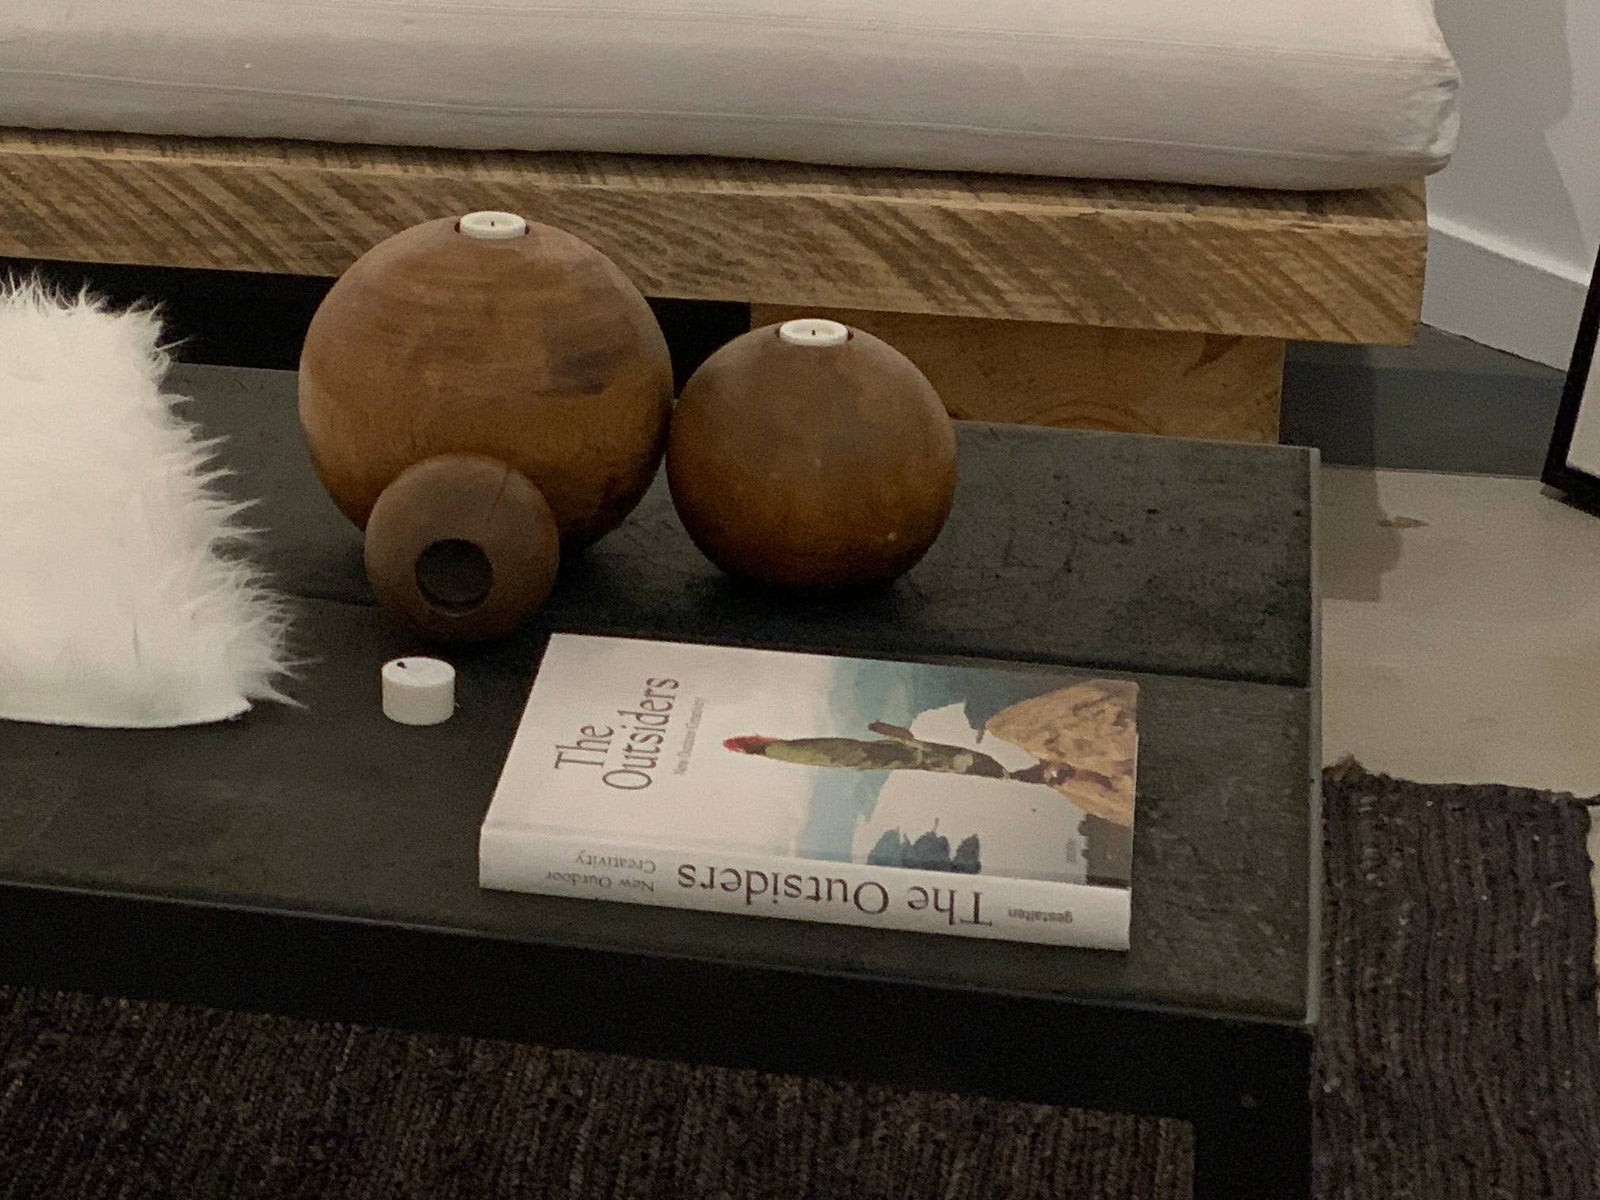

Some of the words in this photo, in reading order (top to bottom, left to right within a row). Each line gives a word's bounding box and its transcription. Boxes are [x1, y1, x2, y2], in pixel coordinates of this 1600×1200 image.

[553, 723, 616, 771] The
[600, 675, 681, 792] Outsiders
[544, 869, 614, 890] Outdoor
[573, 849, 657, 875] Creativity
[618, 878, 656, 895] New
[674, 860, 892, 918] Outsiders
[904, 882, 997, 930] The
